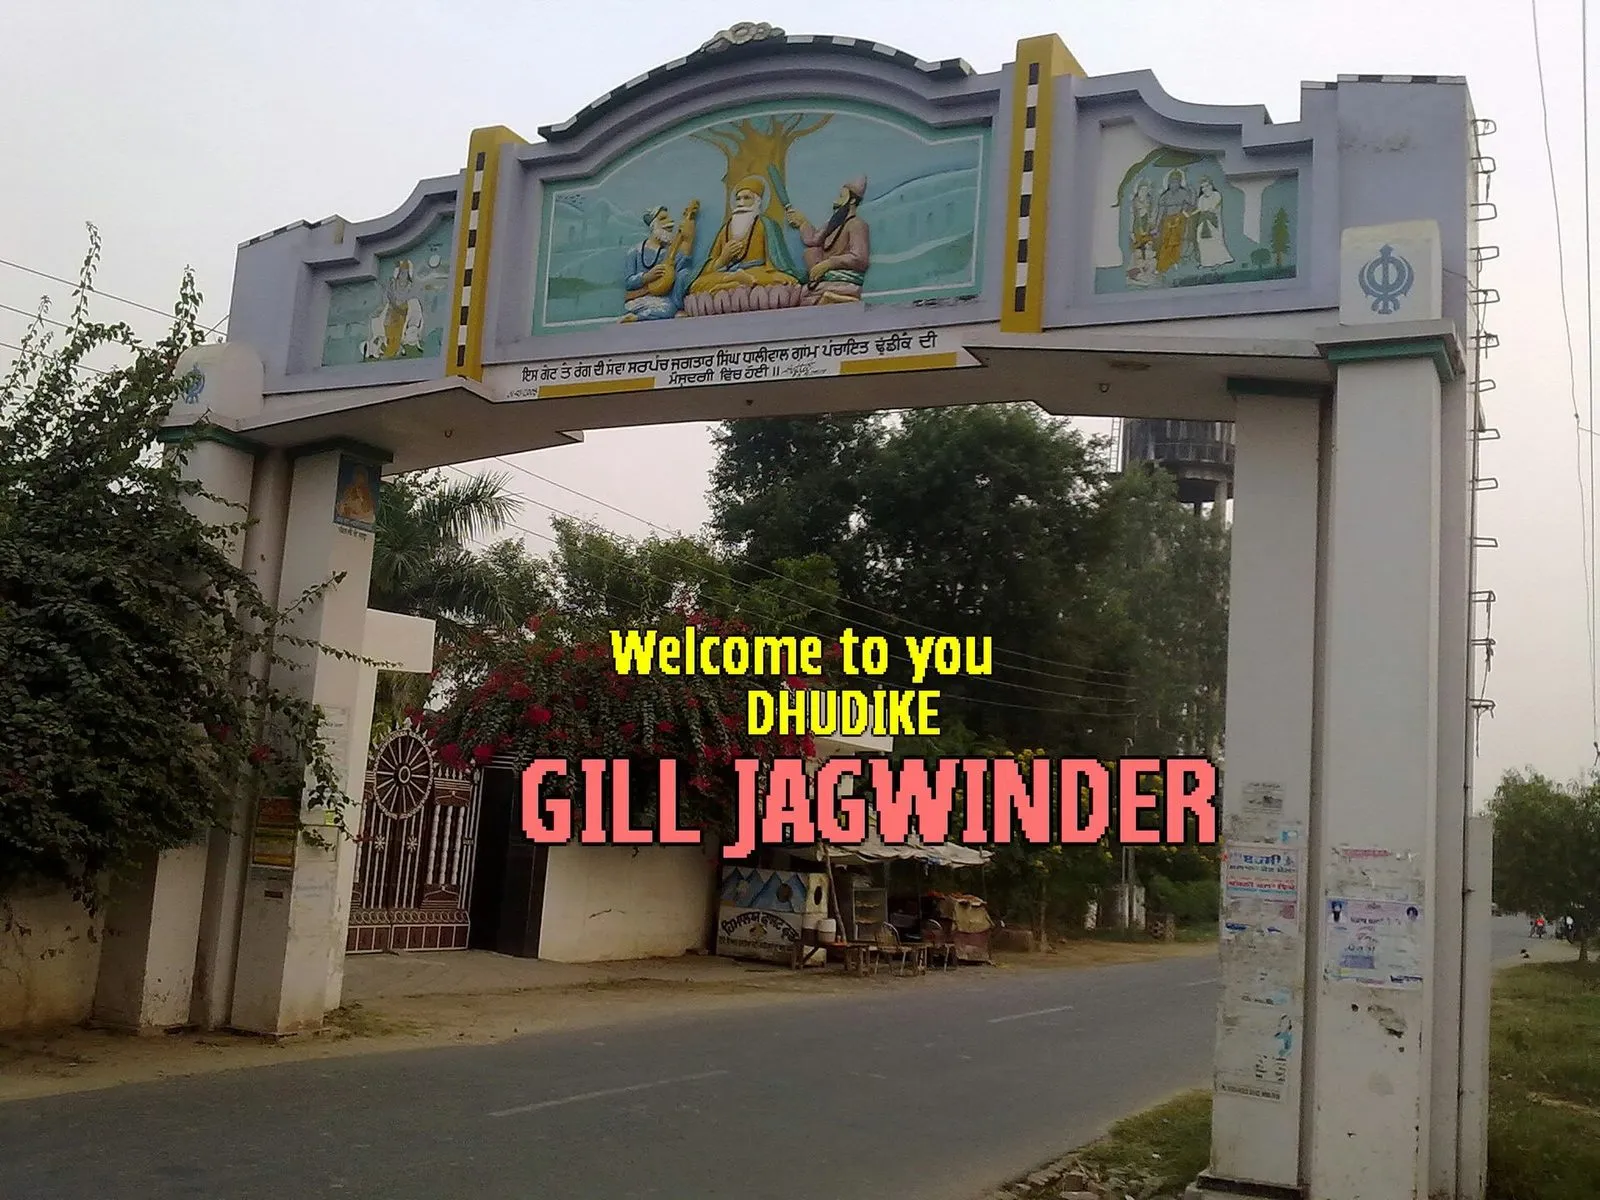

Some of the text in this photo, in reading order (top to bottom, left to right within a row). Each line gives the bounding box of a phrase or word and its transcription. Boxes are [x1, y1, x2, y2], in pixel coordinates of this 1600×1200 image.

[522, 366, 539, 382] ਇਸ
[540, 364, 559, 381] ਗੇਟ
[560, 361, 573, 379] ਤੇ
[574, 361, 592, 378] ਰੰਗ
[593, 360, 605, 376] ਦੀ
[606, 358, 627, 375] ਸੇਵਾ
[627, 355, 670, 374] ਸਰਪੰਚ
[671, 354, 714, 371] ਜਗਤਾਰ
[716, 350, 742, 367] ਸਿੰਘ
[743, 346, 789, 364] ਧਾਲੀਵਾਲ
[822, 338, 870, 357] ਪੰਚਾਇਤ
[918, 330, 938, 349] ਦੀ
